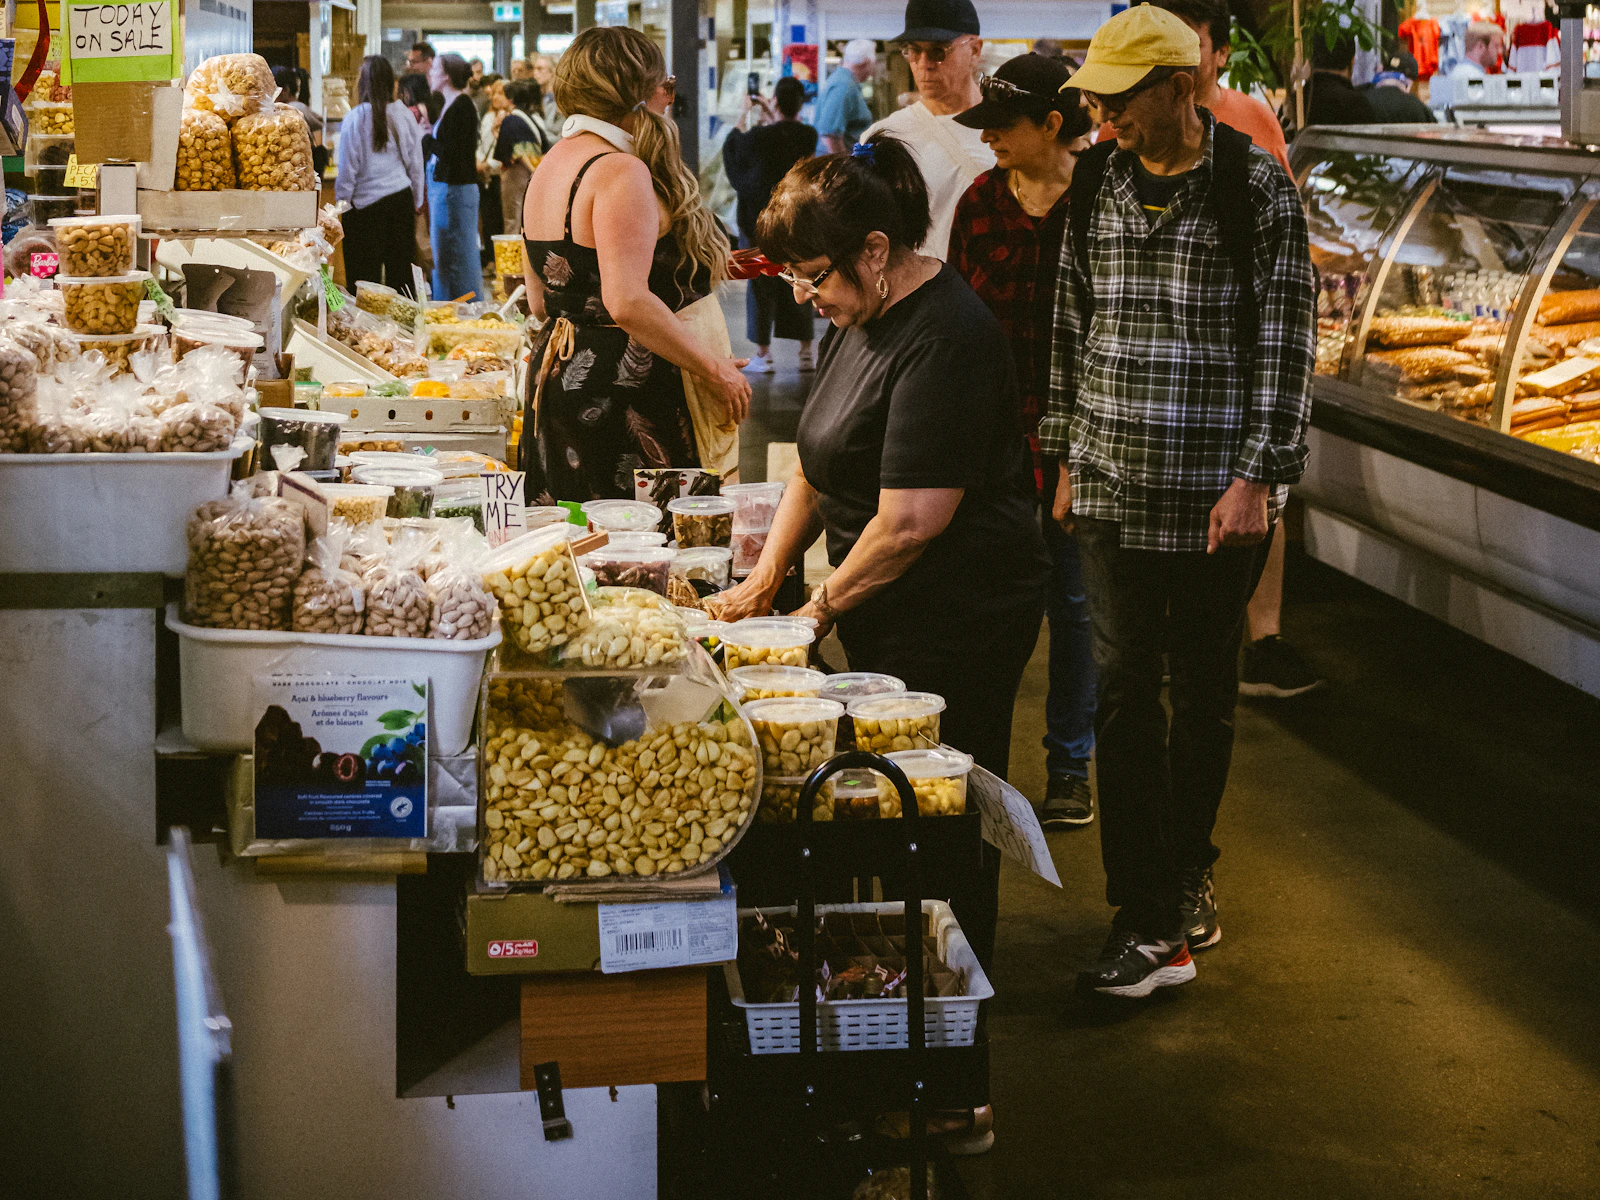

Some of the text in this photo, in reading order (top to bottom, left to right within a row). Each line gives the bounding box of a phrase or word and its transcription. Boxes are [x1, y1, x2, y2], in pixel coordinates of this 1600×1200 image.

[73, 2, 164, 29] TODAY
[75, 32, 102, 52] ON
[110, 25, 163, 52] SALE
[480, 473, 523, 500] TRY
[485, 500, 522, 533] ME
[317, 693, 356, 703] blueberry
[357, 692, 389, 701] flavours
